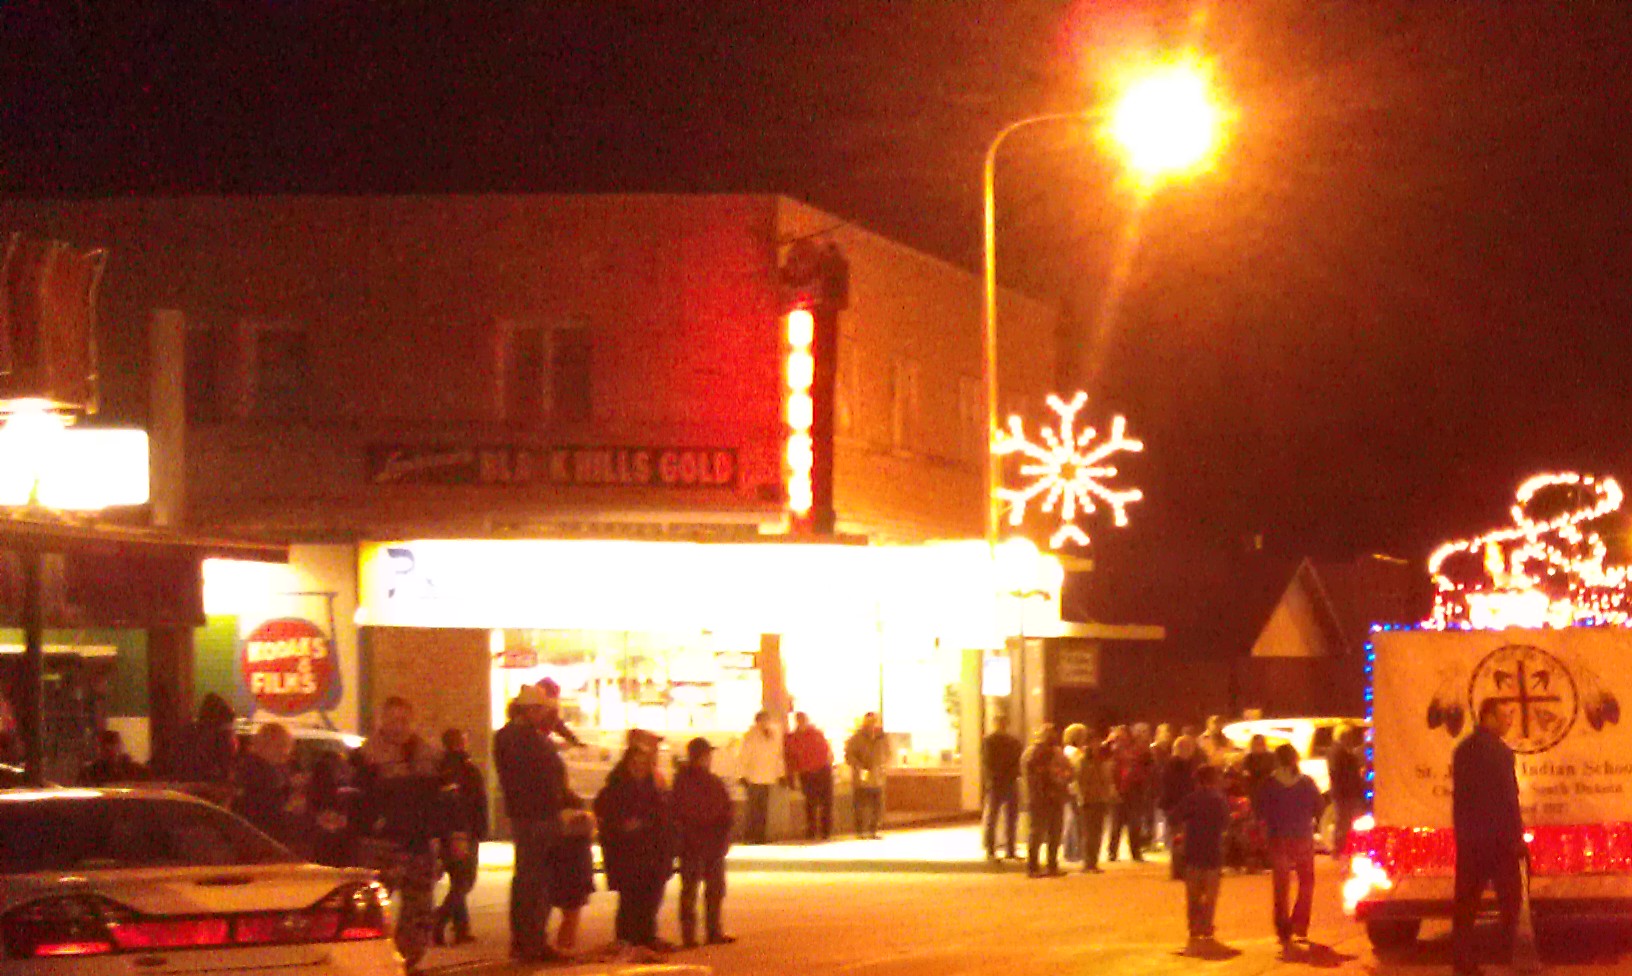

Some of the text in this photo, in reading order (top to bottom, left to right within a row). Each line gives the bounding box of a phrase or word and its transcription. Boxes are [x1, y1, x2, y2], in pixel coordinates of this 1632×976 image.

[479, 451, 571, 484] BLAK
[574, 451, 651, 484] HILLS
[658, 451, 735, 484] GOLD
[251, 671, 317, 694] FILMS
[1521, 760, 1577, 776] Indian
